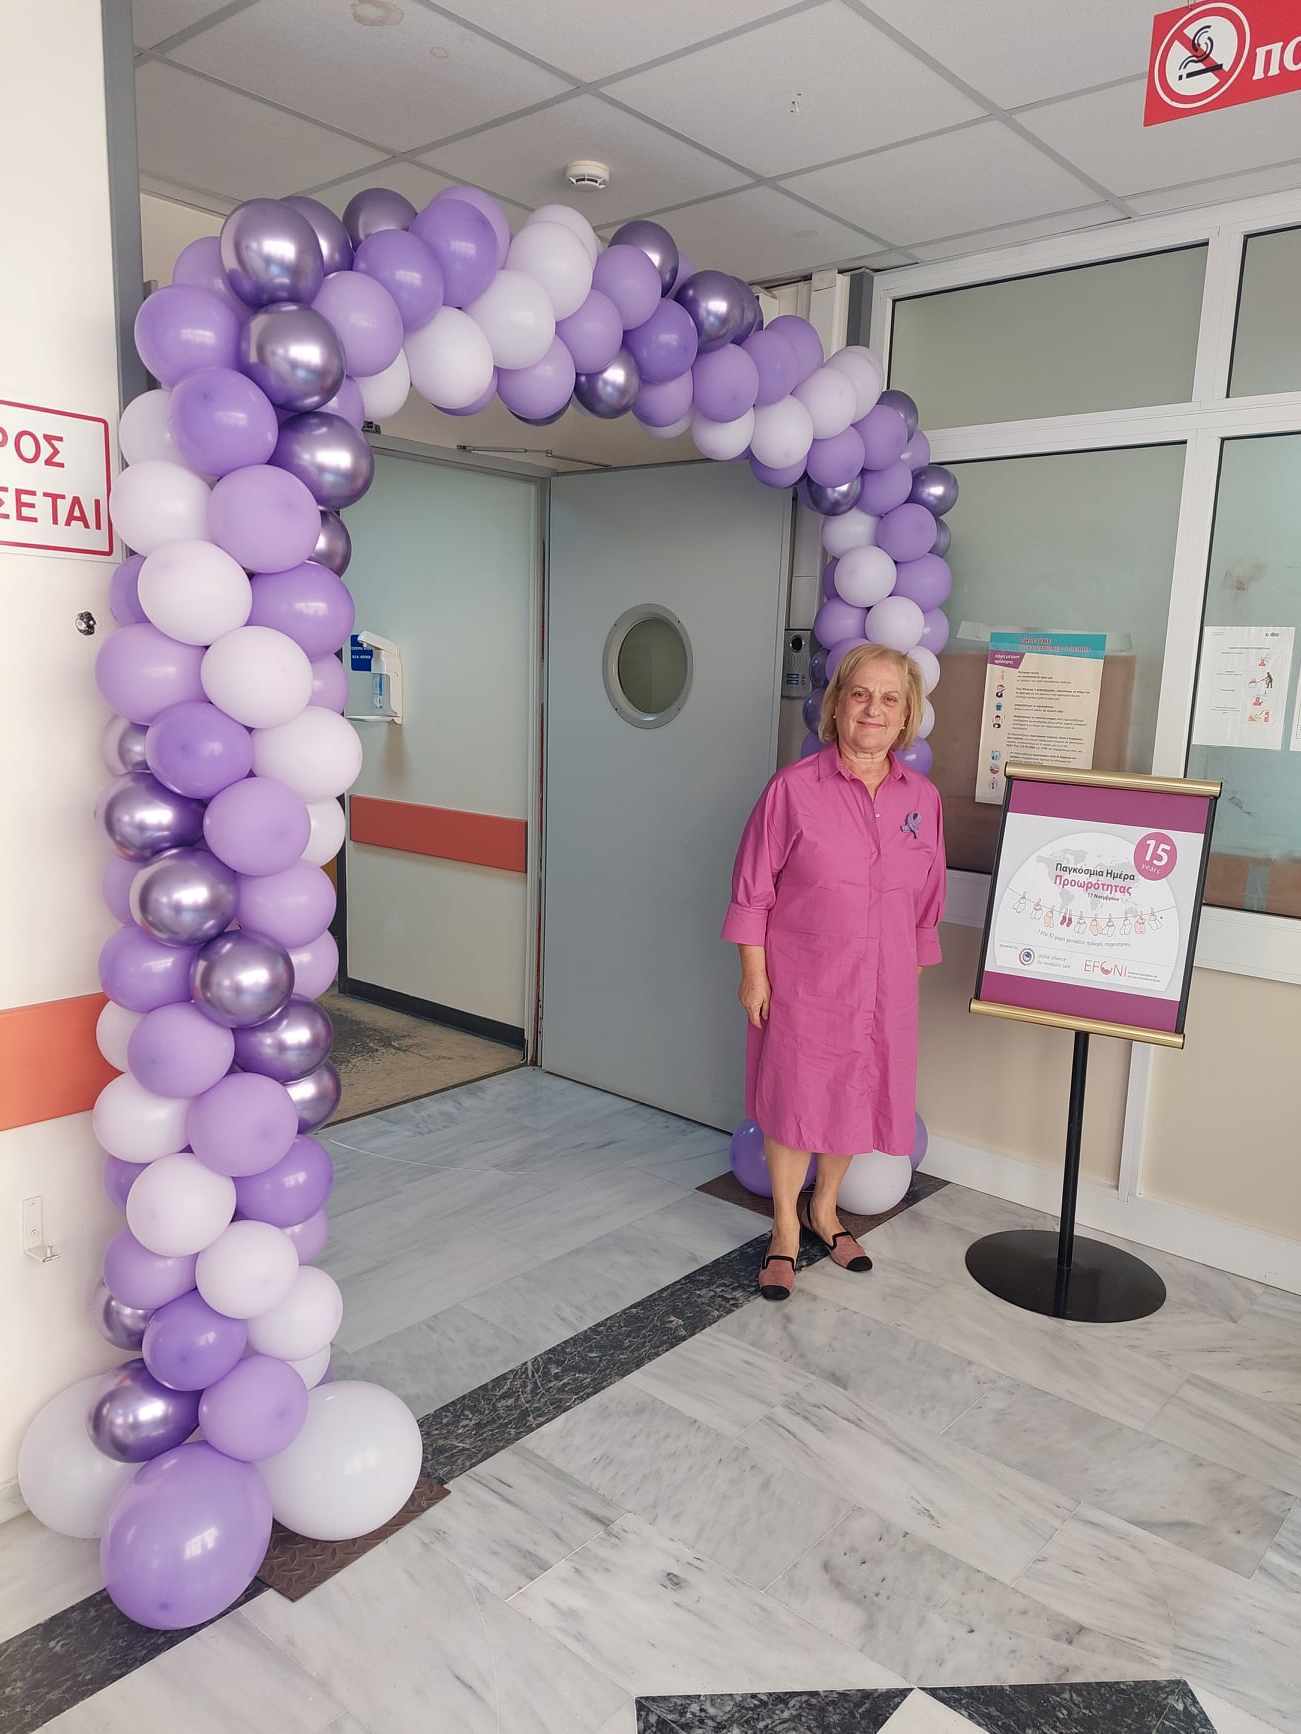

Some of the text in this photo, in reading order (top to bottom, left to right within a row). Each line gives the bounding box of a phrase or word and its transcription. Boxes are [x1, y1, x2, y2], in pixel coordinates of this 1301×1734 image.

[1145, 839, 1171, 866] 15
[1055, 862, 1135, 881] Παγκόσμια Ημέρα
[1054, 875, 1132, 895] Προωρότητας
